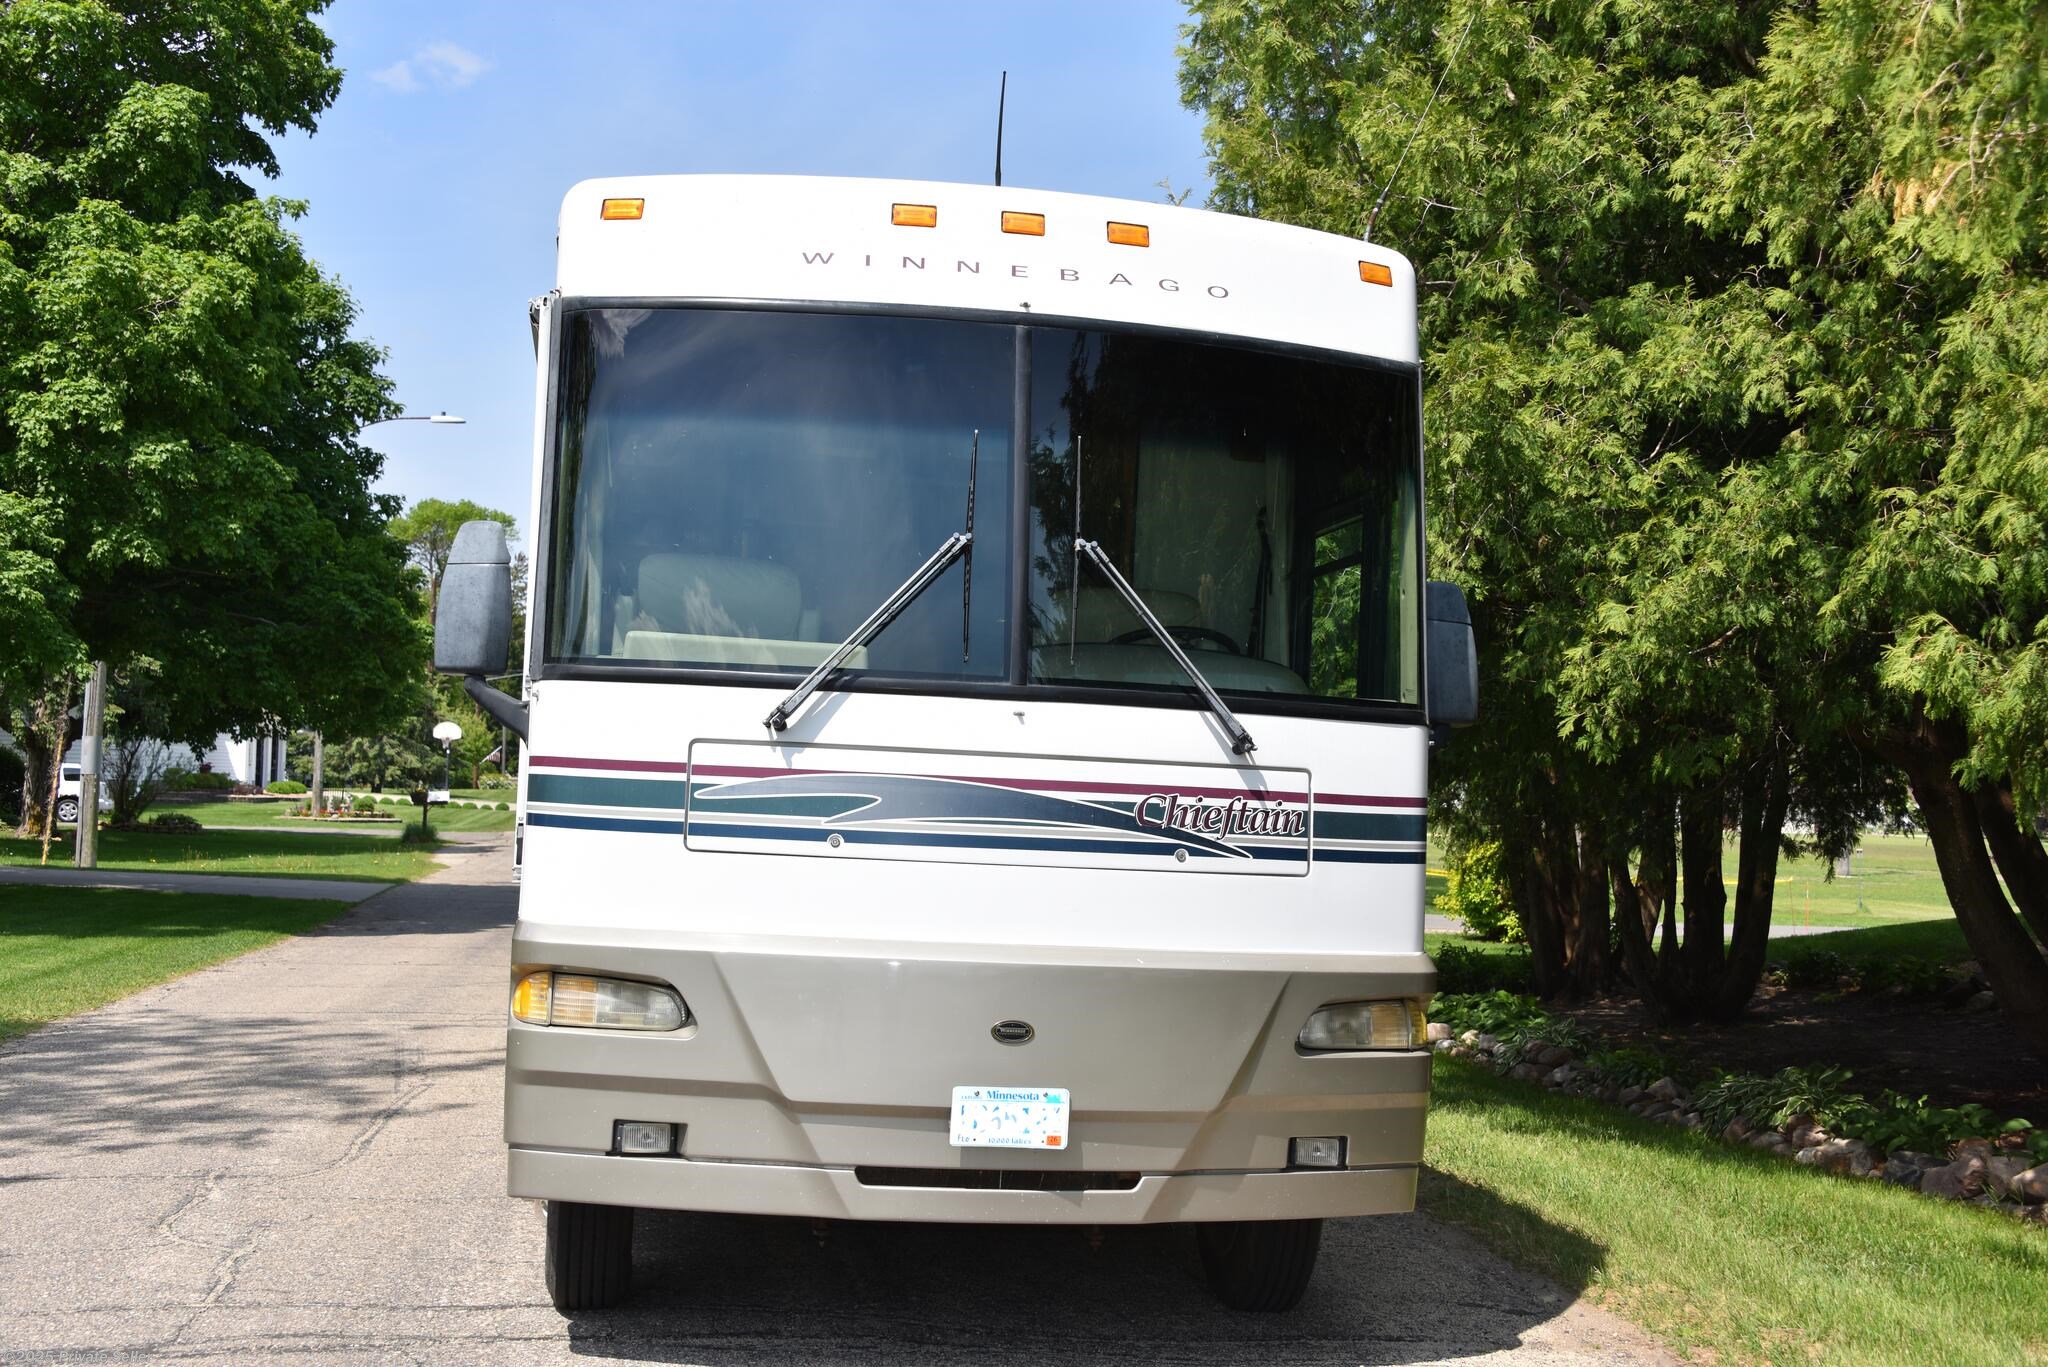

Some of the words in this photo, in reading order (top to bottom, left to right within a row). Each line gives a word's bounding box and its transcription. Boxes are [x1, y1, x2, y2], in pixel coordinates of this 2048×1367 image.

[802, 252, 1229, 299] WINNEBAGO
[1135, 793, 1305, 840] Chieftain
[987, 1090, 1040, 1101] Minnesota
